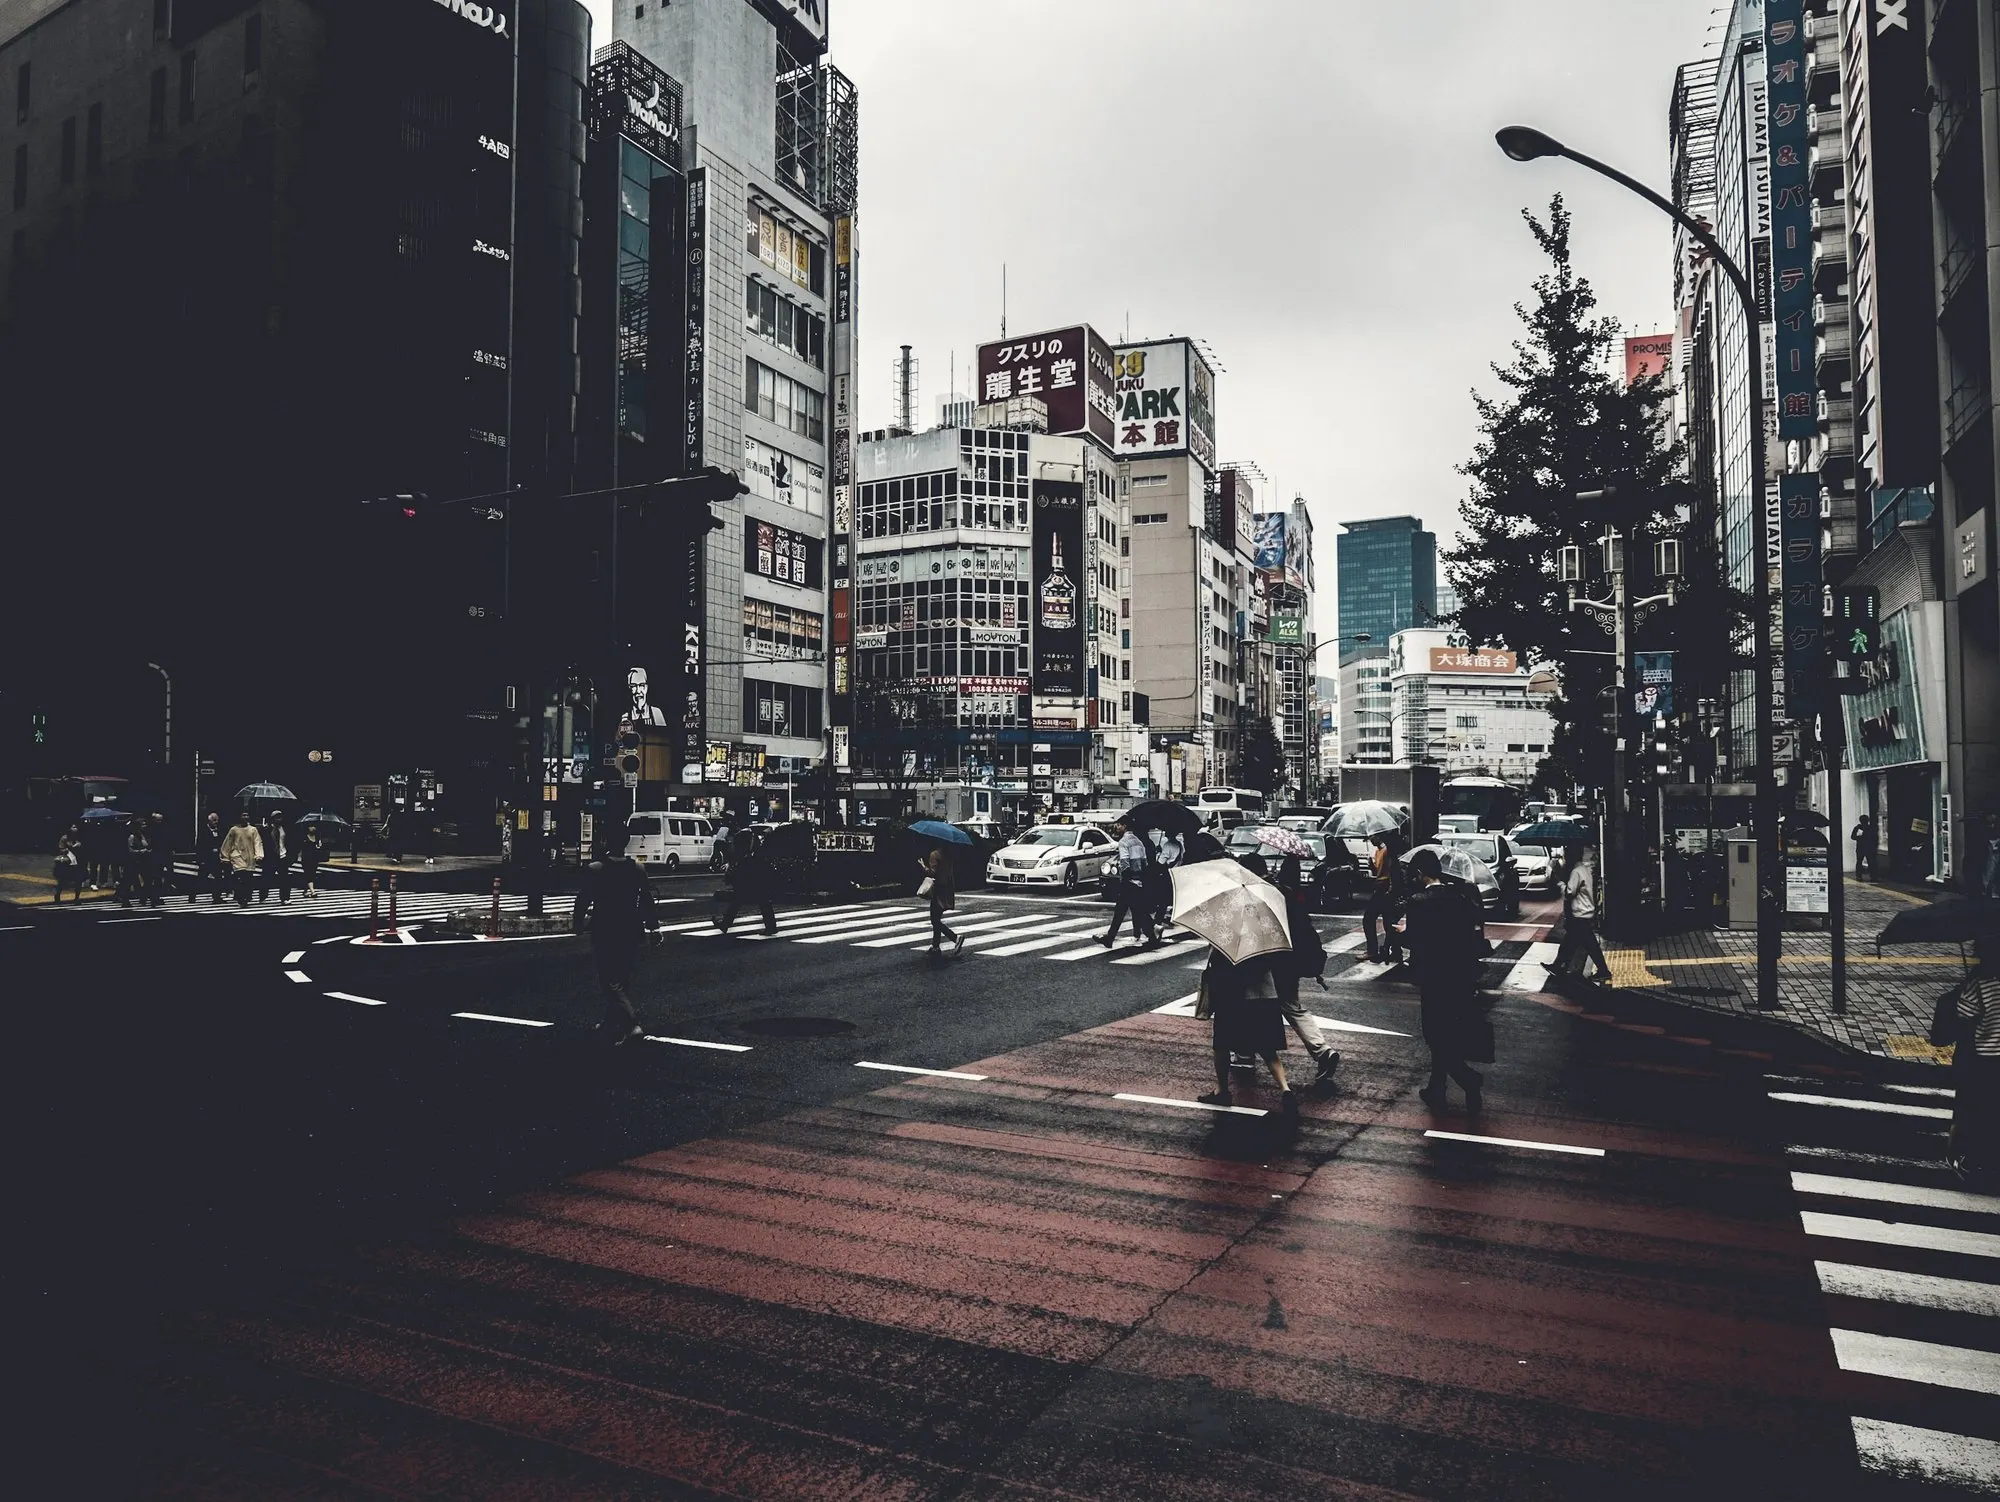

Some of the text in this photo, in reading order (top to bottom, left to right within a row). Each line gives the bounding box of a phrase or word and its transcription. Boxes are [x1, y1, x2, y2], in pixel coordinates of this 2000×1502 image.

[1752, 85, 1765, 154] TSUTAYA
[1755, 164, 1770, 234] TSUTAYA
[1769, 0, 1812, 417] ラオケ&パーティー館
[996, 338, 1063, 365] クスリの
[1089, 346, 1113, 381] クスリの
[1632, 342, 1672, 354] PROMIS
[984, 358, 1077, 401] 龍生堂
[1115, 377, 1145, 391] JUKU
[687, 399, 696, 446] ともしび
[1121, 419, 1180, 447] 本館
[1764, 490, 1780, 566] TSUTAYA
[836, 580, 846, 588] 2F
[1786, 494, 1817, 651] カラオケ
[1278, 628, 1298, 636] ALSA
[1279, 619, 1298, 629] レイク
[685, 622, 699, 675] KFC
[1436, 653, 1510, 669] 大塚商会
[760, 699, 784, 722] 和民
